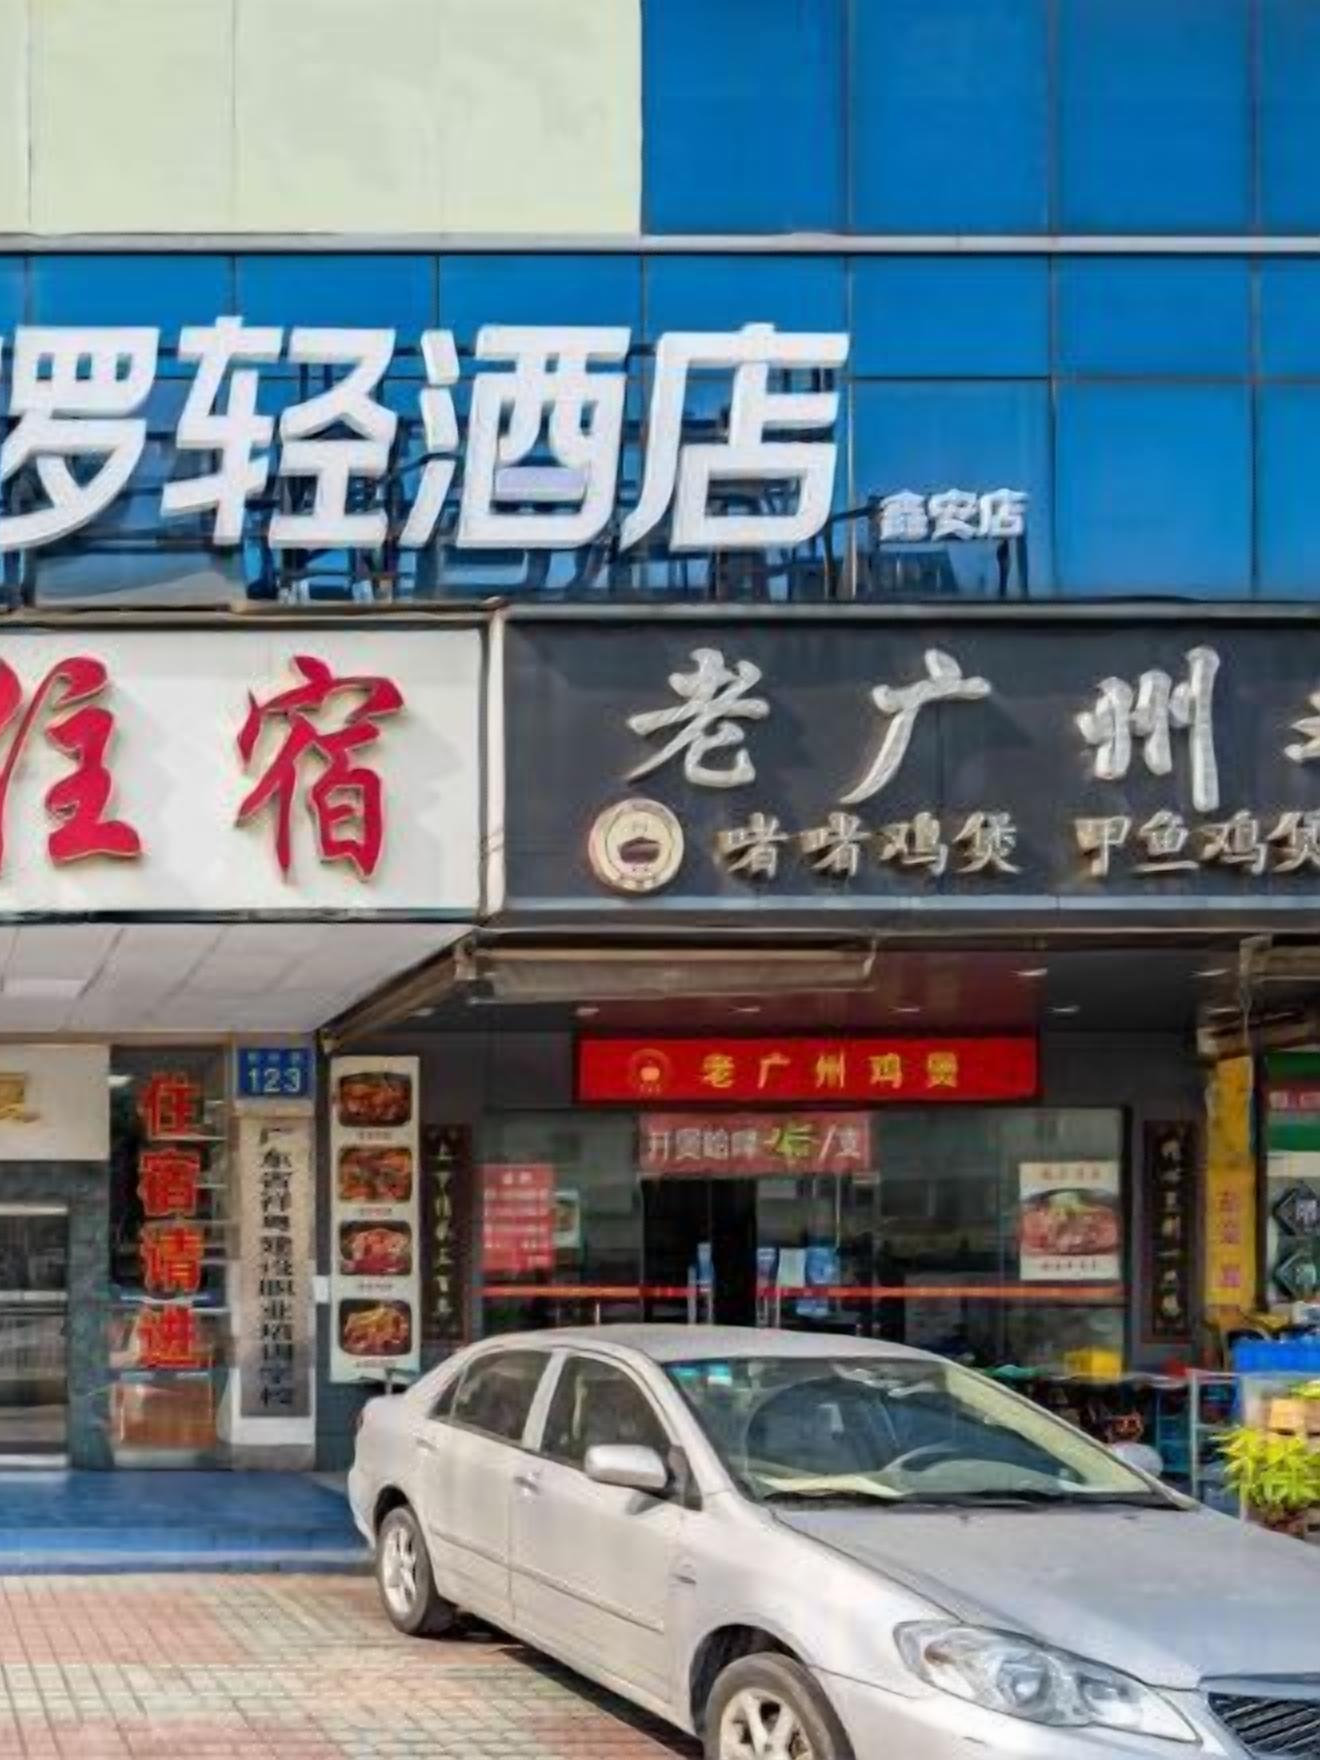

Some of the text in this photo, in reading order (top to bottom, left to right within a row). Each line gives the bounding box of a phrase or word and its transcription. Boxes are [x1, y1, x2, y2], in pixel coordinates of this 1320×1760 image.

[879, 487, 1029, 541] 鑫安店
[248, 1067, 301, 1093] 123
[700, 1048, 958, 1089] 老广州鸡煲
